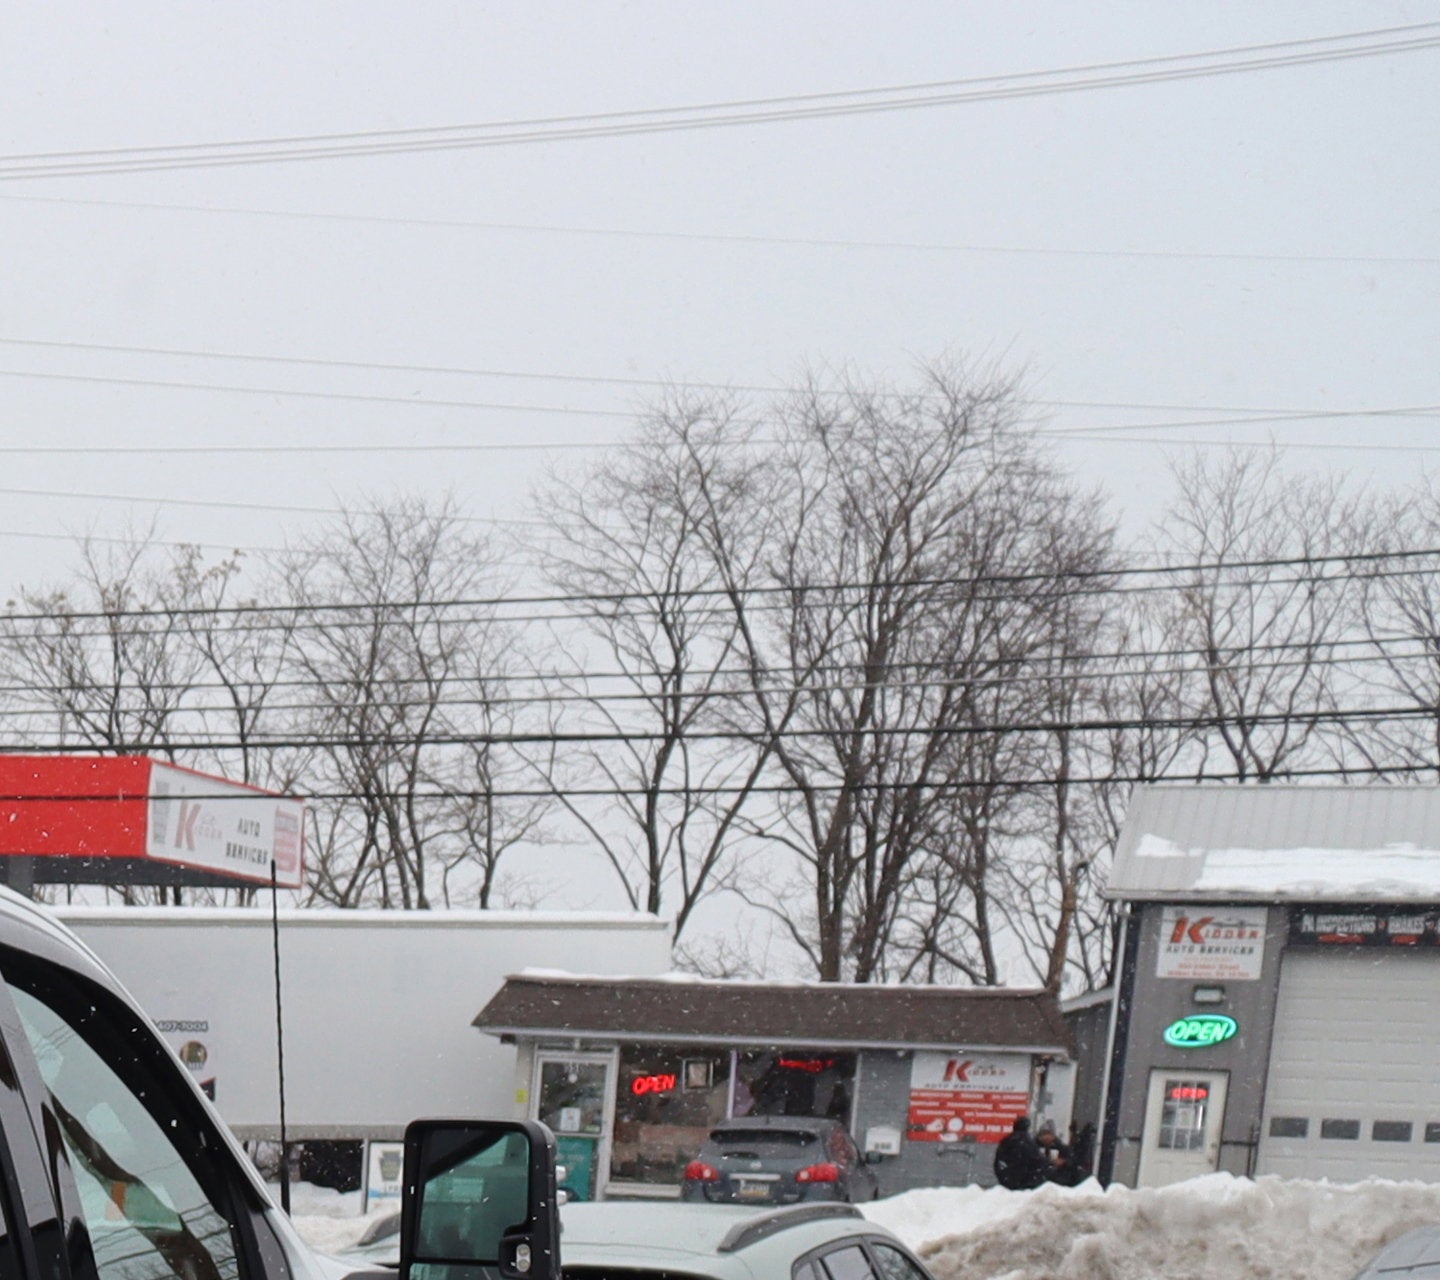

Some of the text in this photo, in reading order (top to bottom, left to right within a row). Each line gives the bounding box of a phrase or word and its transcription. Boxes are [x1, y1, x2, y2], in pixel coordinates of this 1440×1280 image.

[237, 817, 261, 838] AUTO
[225, 841, 269, 865] SERVICES
[1169, 916, 1259, 944] KIDDER
[1166, 944, 1255, 955] AUTO SERVICES
[1170, 1020, 1229, 1042] OPEN
[632, 1074, 676, 1095] OPEN
